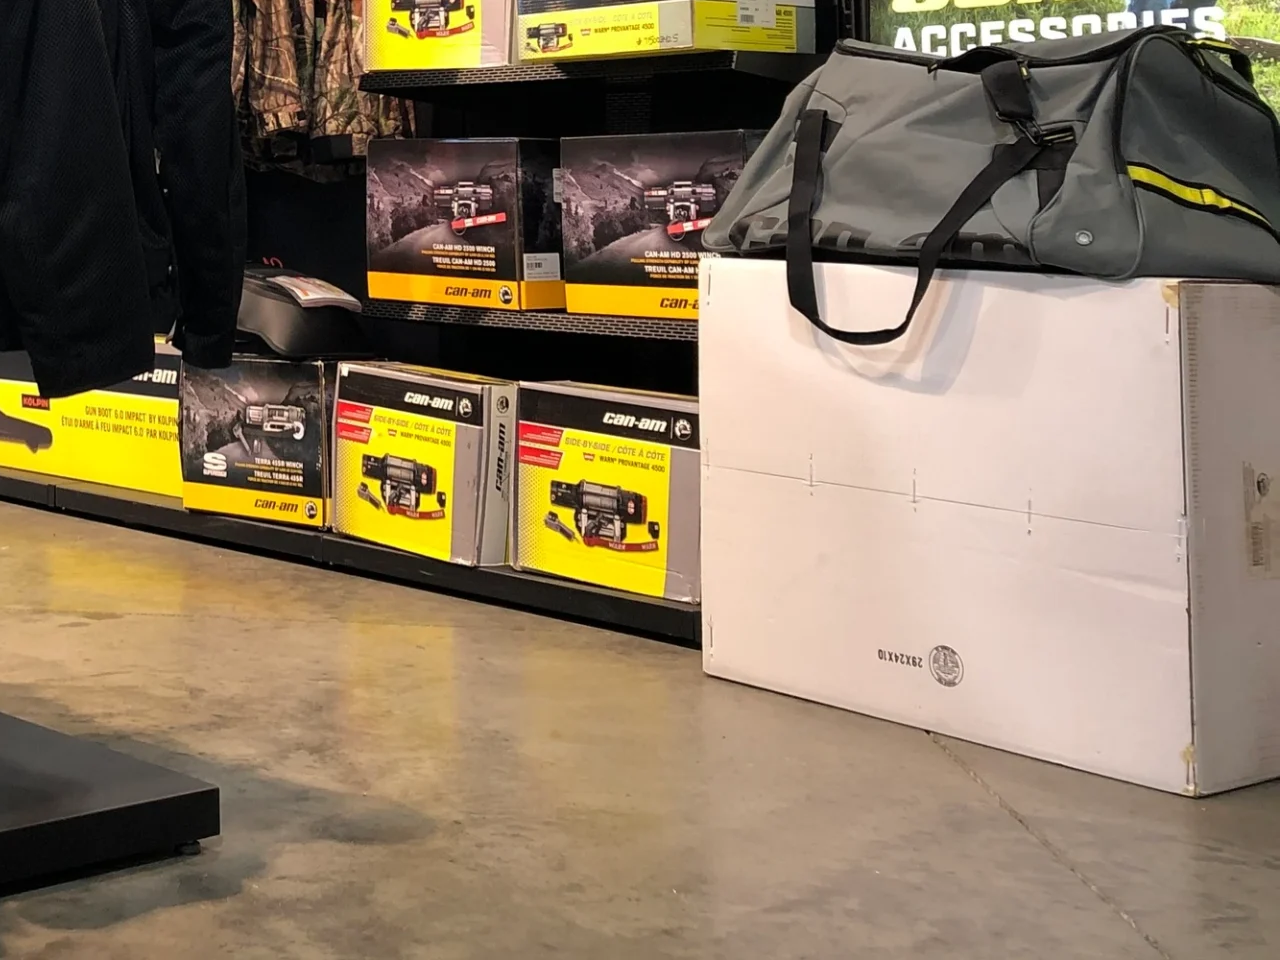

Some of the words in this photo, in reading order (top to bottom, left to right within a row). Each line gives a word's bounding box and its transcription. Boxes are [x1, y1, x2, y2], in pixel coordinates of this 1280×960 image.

[668, 266, 694, 274] CAN-AM
[445, 286, 492, 299] can-am
[23, 396, 48, 407] KOLPIN
[404, 392, 453, 411] can-am
[85, 405, 97, 416] GUN
[149, 414, 156, 424] BY
[374, 415, 409, 428] SIDE-BY-SIDE
[603, 412, 667, 433] can-am
[100, 422, 110, 432] FEU
[146, 428, 157, 439] PAR
[565, 437, 610, 452] SIDE-BY-SIDE
[617, 445, 636, 456] CÔTE
[646, 450, 665, 461] CÔTE
[255, 457, 271, 466] TERRA
[495, 423, 506, 492] can-am
[618, 459, 650, 470] PROVANTAGE
[651, 465, 665, 473] 4500
[254, 470, 271, 478] TREUIL
[272, 472, 289, 480] TERRA
[255, 499, 298, 513] can-am
[878, 649, 923, 668] 29X24X10
